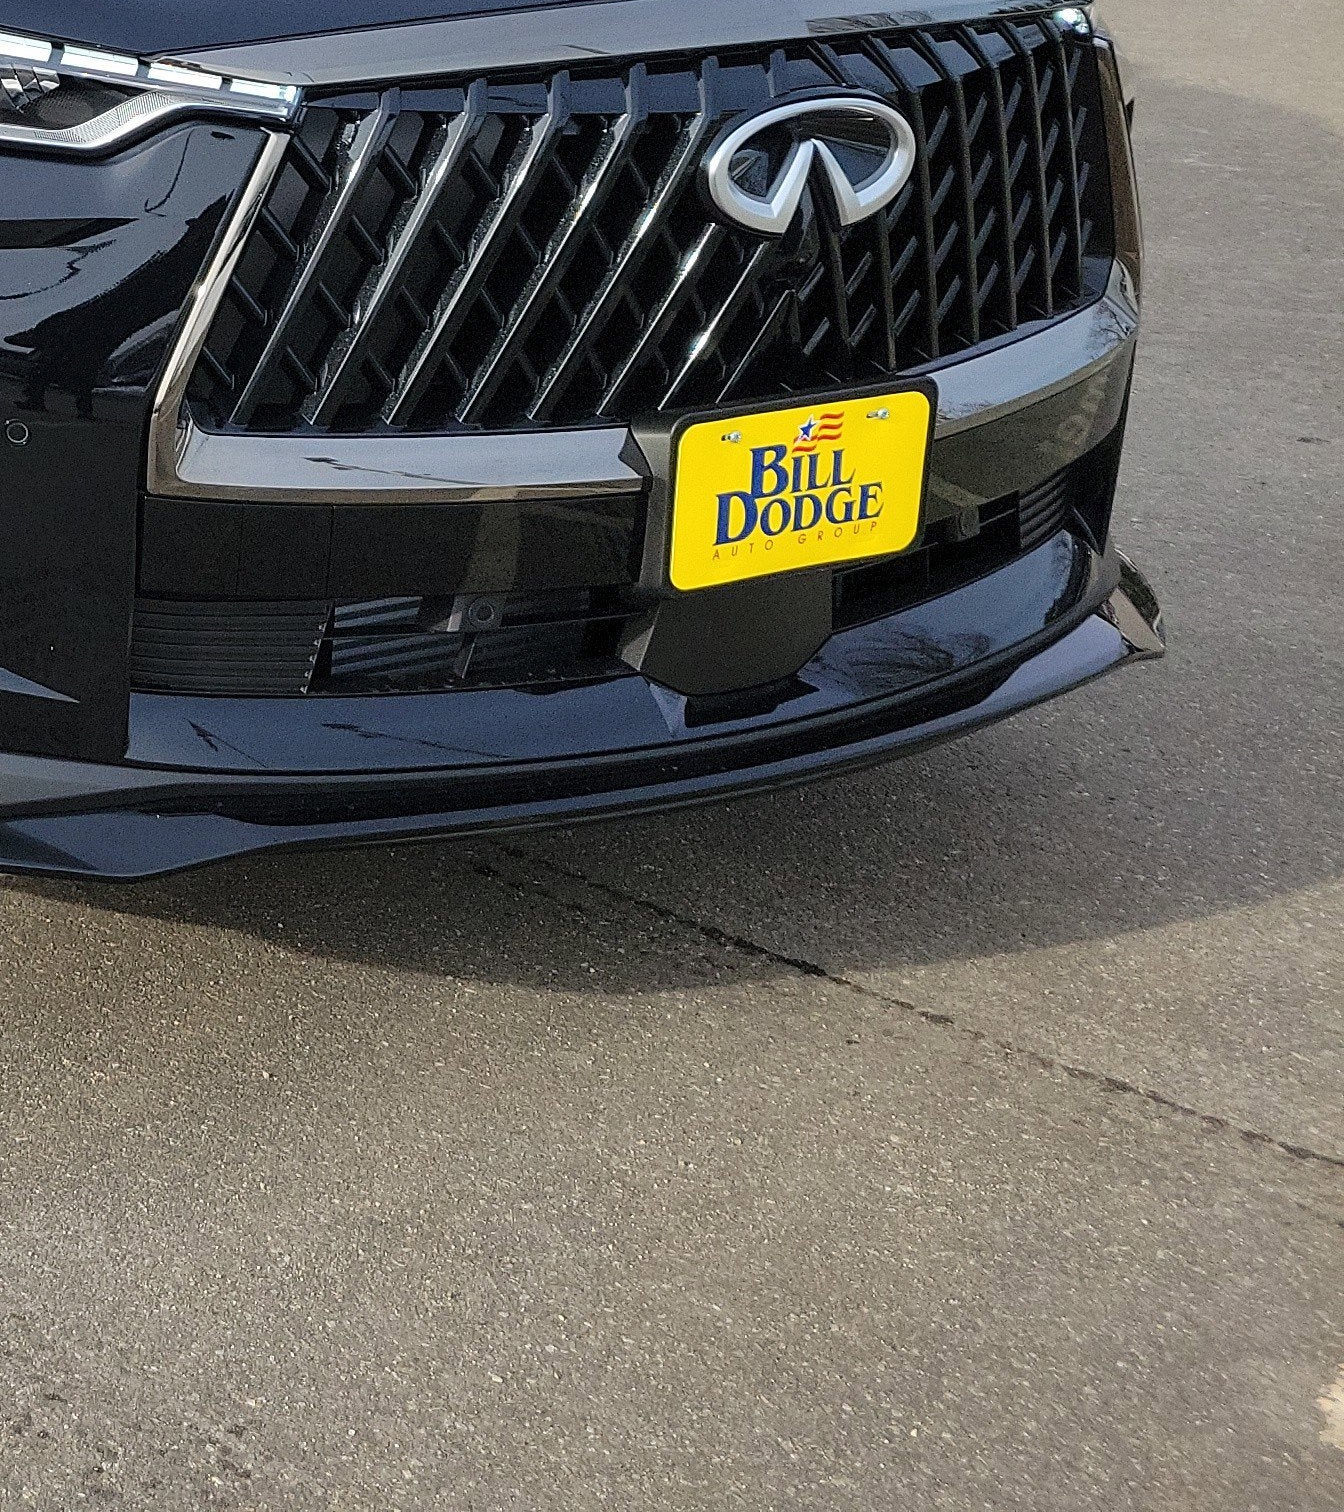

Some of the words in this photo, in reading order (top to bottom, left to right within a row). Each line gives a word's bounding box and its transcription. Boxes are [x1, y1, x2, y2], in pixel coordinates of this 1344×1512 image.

[748, 442, 857, 499] BILL
[711, 539, 775, 561] AUTO
[797, 520, 879, 545] GROUP
[712, 481, 886, 547] DODGE
